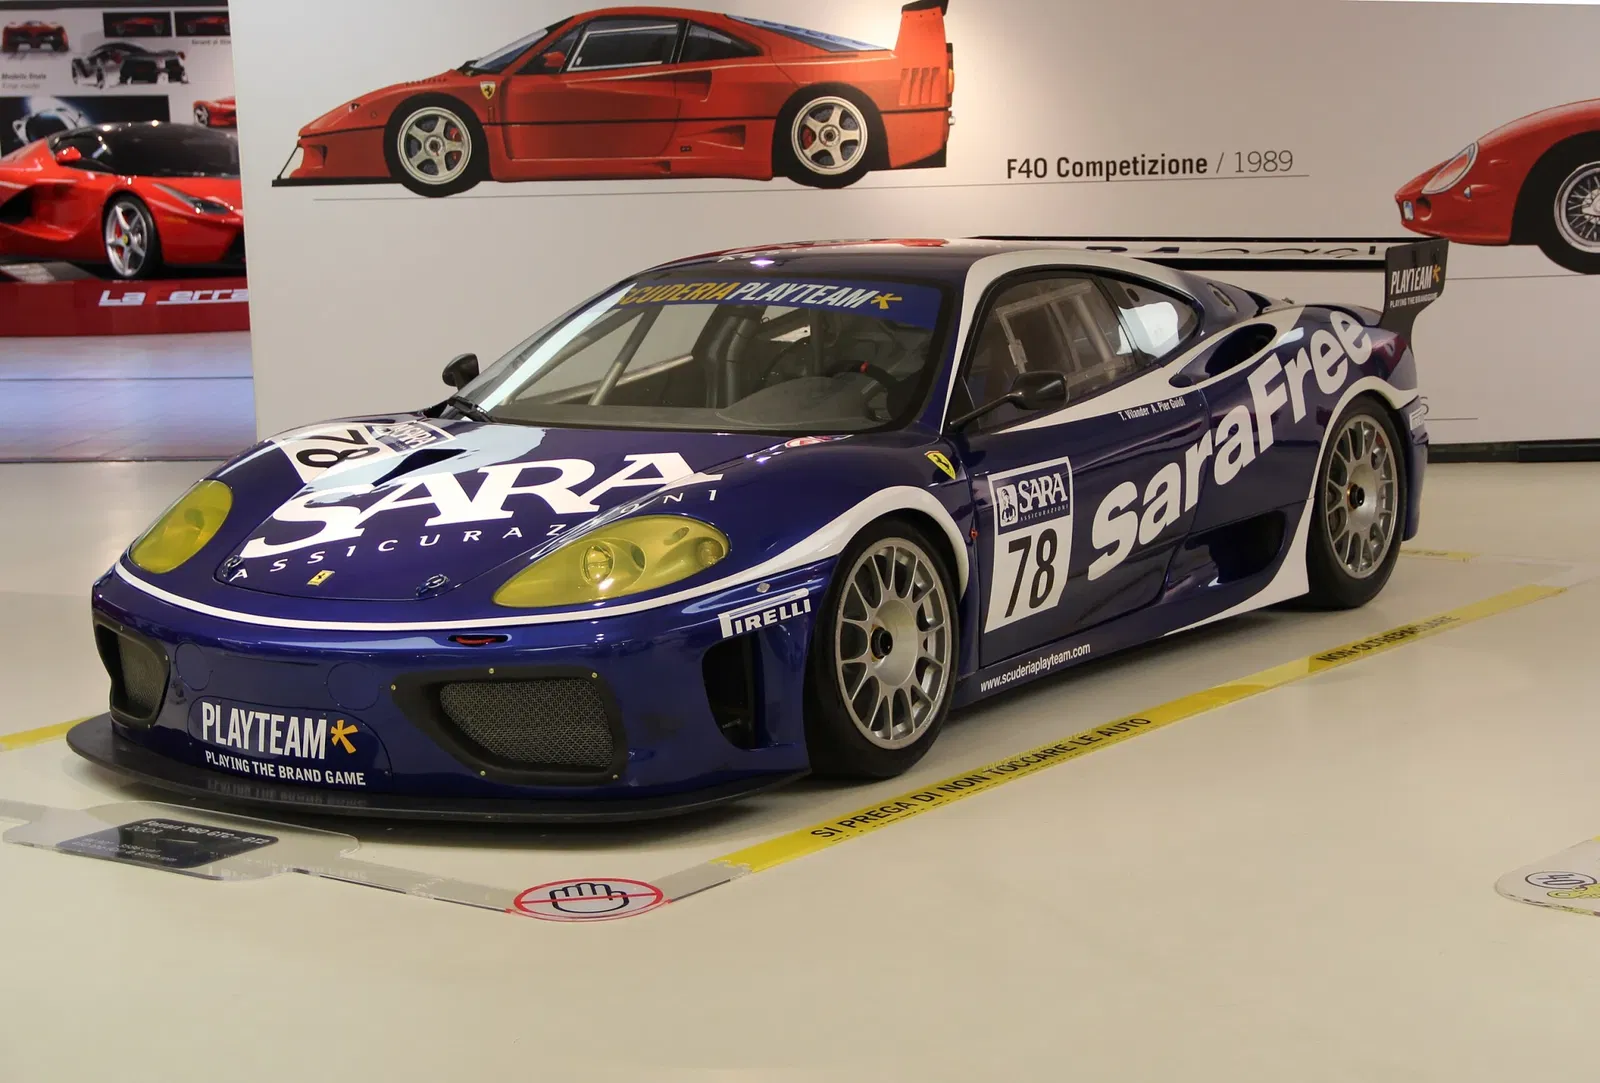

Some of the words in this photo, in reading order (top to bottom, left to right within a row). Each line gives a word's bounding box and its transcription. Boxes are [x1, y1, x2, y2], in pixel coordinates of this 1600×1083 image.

[1006, 157, 1048, 179] F40
[1056, 154, 1208, 182] Competizione
[1234, 150, 1294, 173] 1989
[1390, 265, 1433, 295] PLAYTEAM
[1157, 401, 1171, 412] Pier
[240, 452, 723, 558] SARA
[1018, 472, 1068, 513] SARA
[1020, 504, 1069, 521] ASSICURAZIONI
[1004, 528, 1058, 618] 78
[718, 588, 811, 638] PIRELLI
[980, 644, 1091, 693] www.scuderiaplayteam.com
[202, 701, 327, 760] PLAYTEAM
[205, 750, 250, 773] PLAYING
[251, 761, 276, 777] THE
[279, 765, 321, 783] BRAND
[325, 770, 366, 786] GAME
[811, 826, 843, 838] SI
[836, 801, 918, 828] PREGA
[910, 791, 943, 803] DI
[936, 774, 991, 793] NON
[983, 744, 1077, 775] TOCCARE
[1069, 735, 1103, 746] LE
[1097, 718, 1152, 738] AUTO
